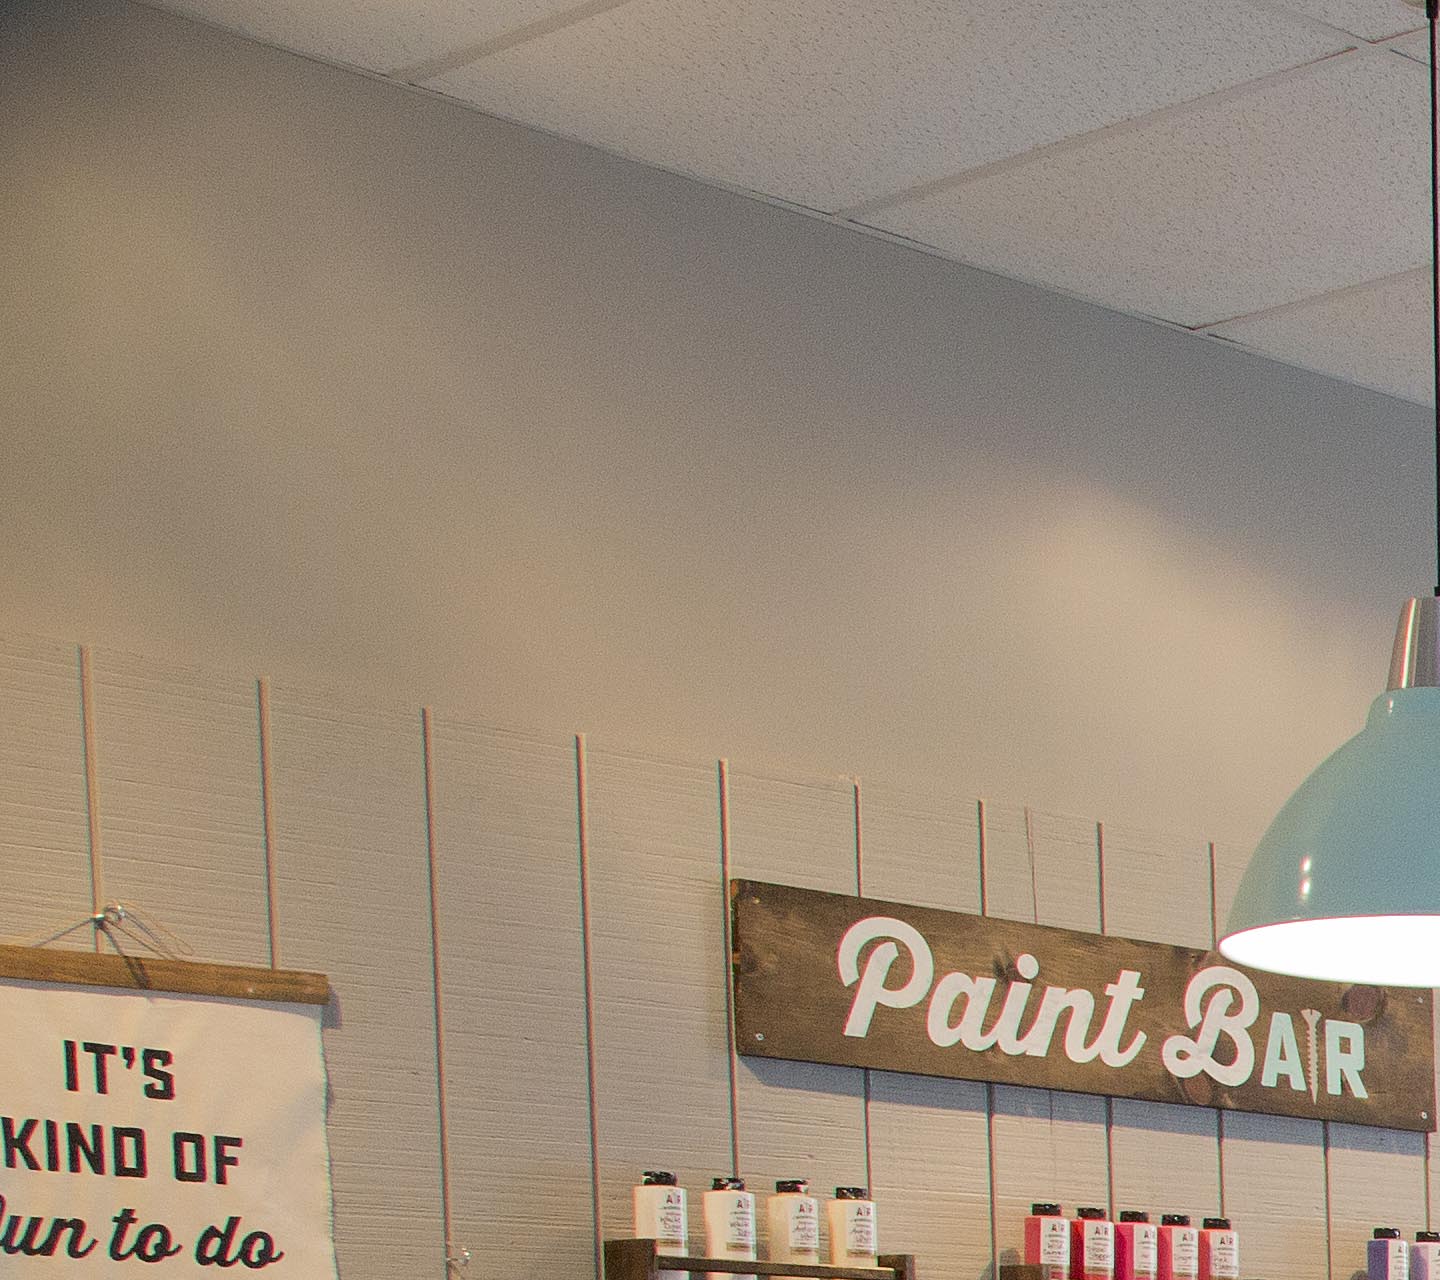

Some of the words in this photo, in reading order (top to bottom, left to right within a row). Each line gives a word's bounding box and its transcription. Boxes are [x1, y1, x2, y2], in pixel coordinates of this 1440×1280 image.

[838, 916, 1148, 1067] Paint
[63, 1039, 176, 1100] IT'S
[1, 1116, 149, 1179] KIND
[172, 1130, 244, 1185] OF
[109, 1206, 183, 1264] to
[195, 1215, 285, 1270] do
